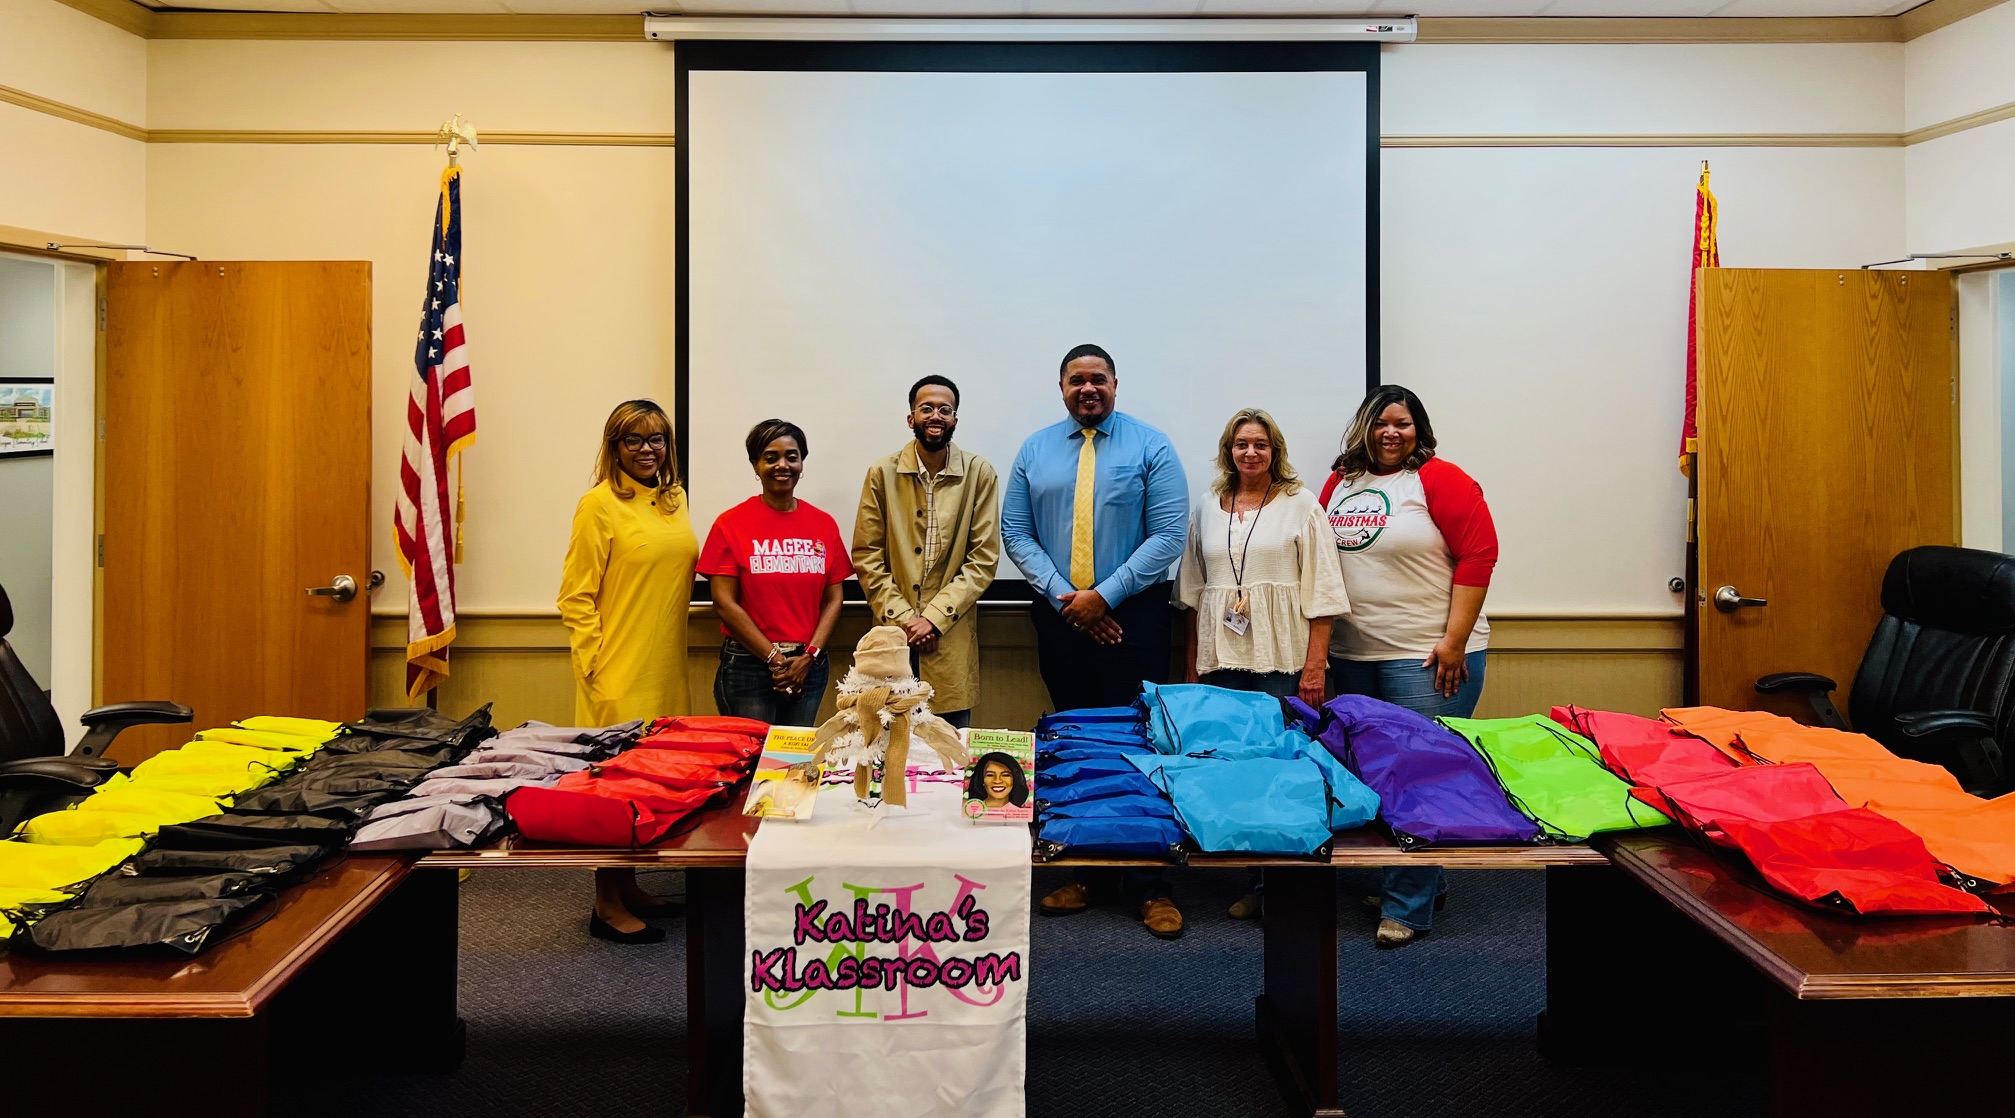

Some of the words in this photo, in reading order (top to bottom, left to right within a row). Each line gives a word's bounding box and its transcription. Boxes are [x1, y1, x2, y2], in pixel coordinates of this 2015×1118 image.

[752, 538, 815, 555] MAGEE
[1336, 538, 1358, 547] CREW
[749, 555, 826, 574] ELEMENTARY
[974, 732, 994, 740] Born
[1006, 735, 1028, 743] Lead!
[794, 894, 989, 945] Katina's
[751, 946, 1021, 992] Klassroom
